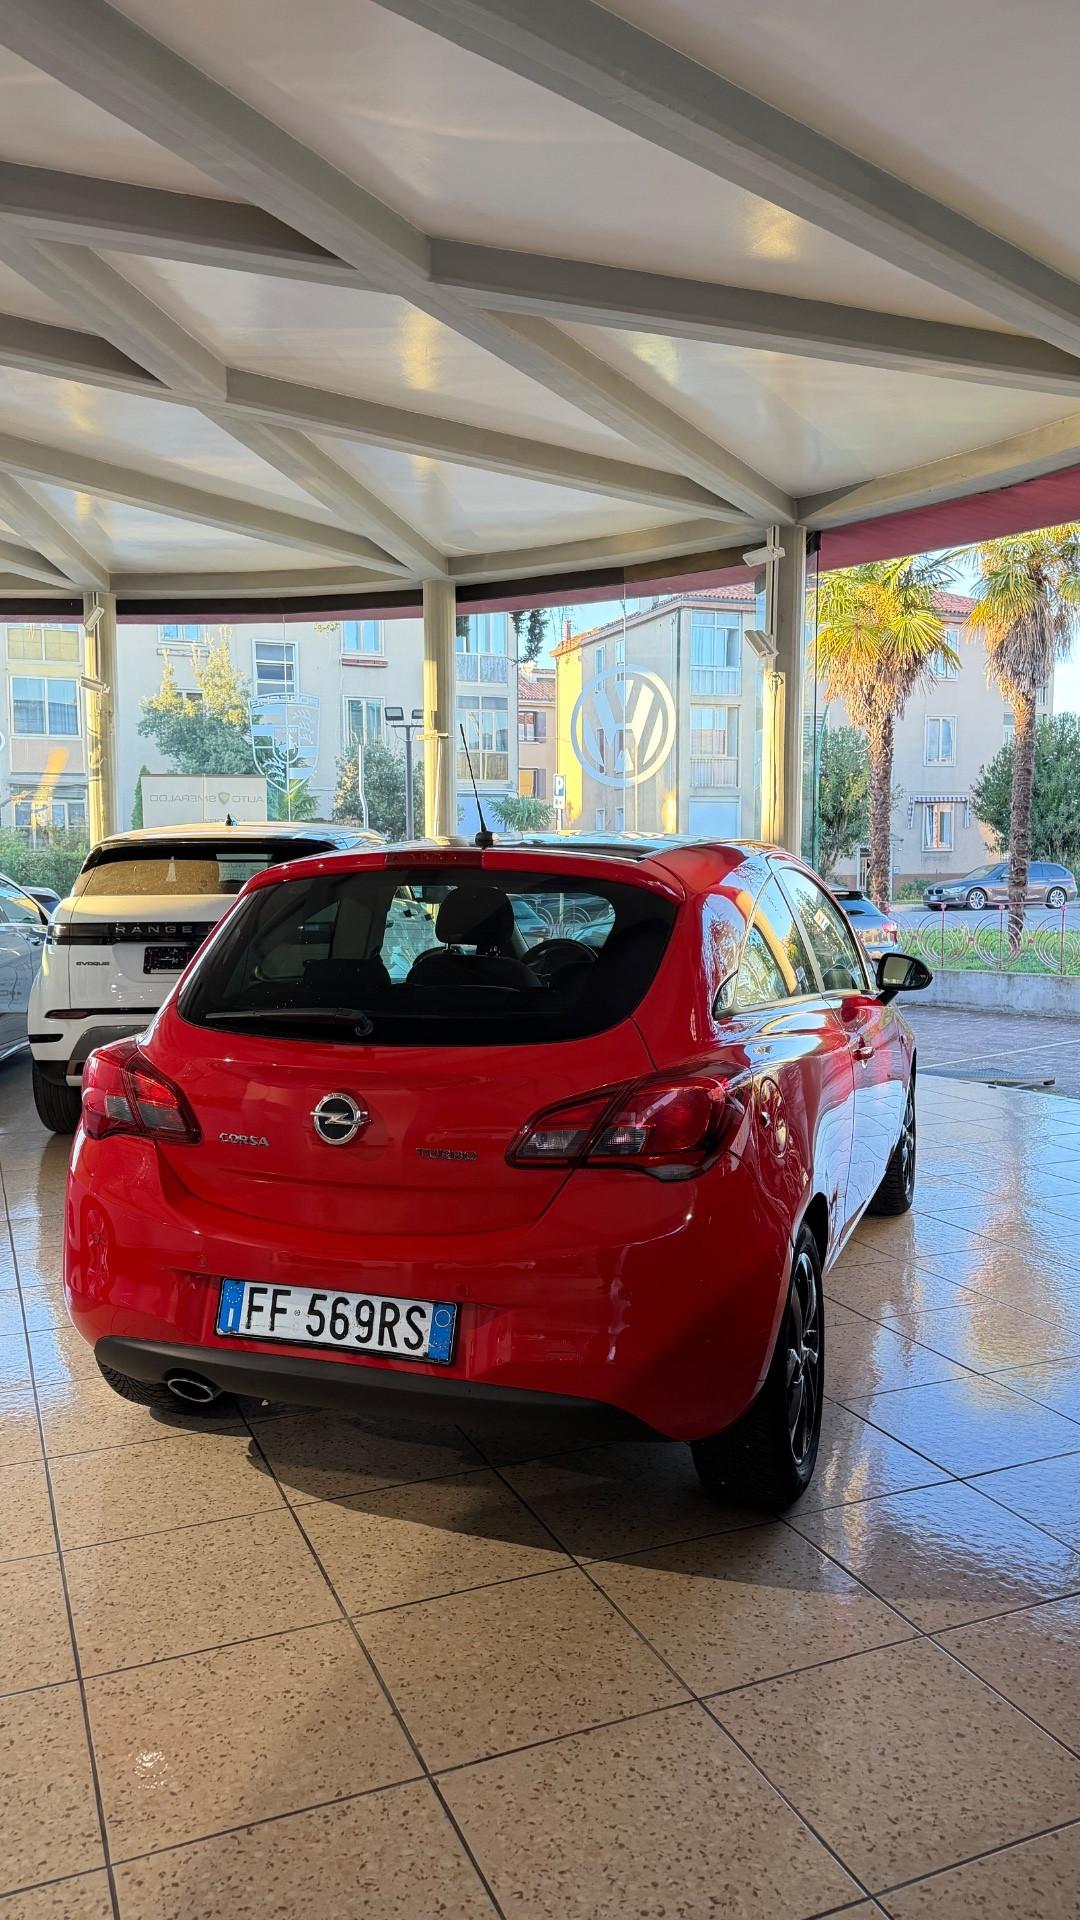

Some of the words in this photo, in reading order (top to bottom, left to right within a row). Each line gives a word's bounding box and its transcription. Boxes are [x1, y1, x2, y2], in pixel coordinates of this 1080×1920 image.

[555, 775, 564, 796] P
[115, 926, 193, 934] RANGE
[219, 1132, 269, 1147] CORSA
[416, 1147, 477, 1161] TURBO
[245, 1287, 292, 1331] FF
[305, 1293, 427, 1350] 569RS
